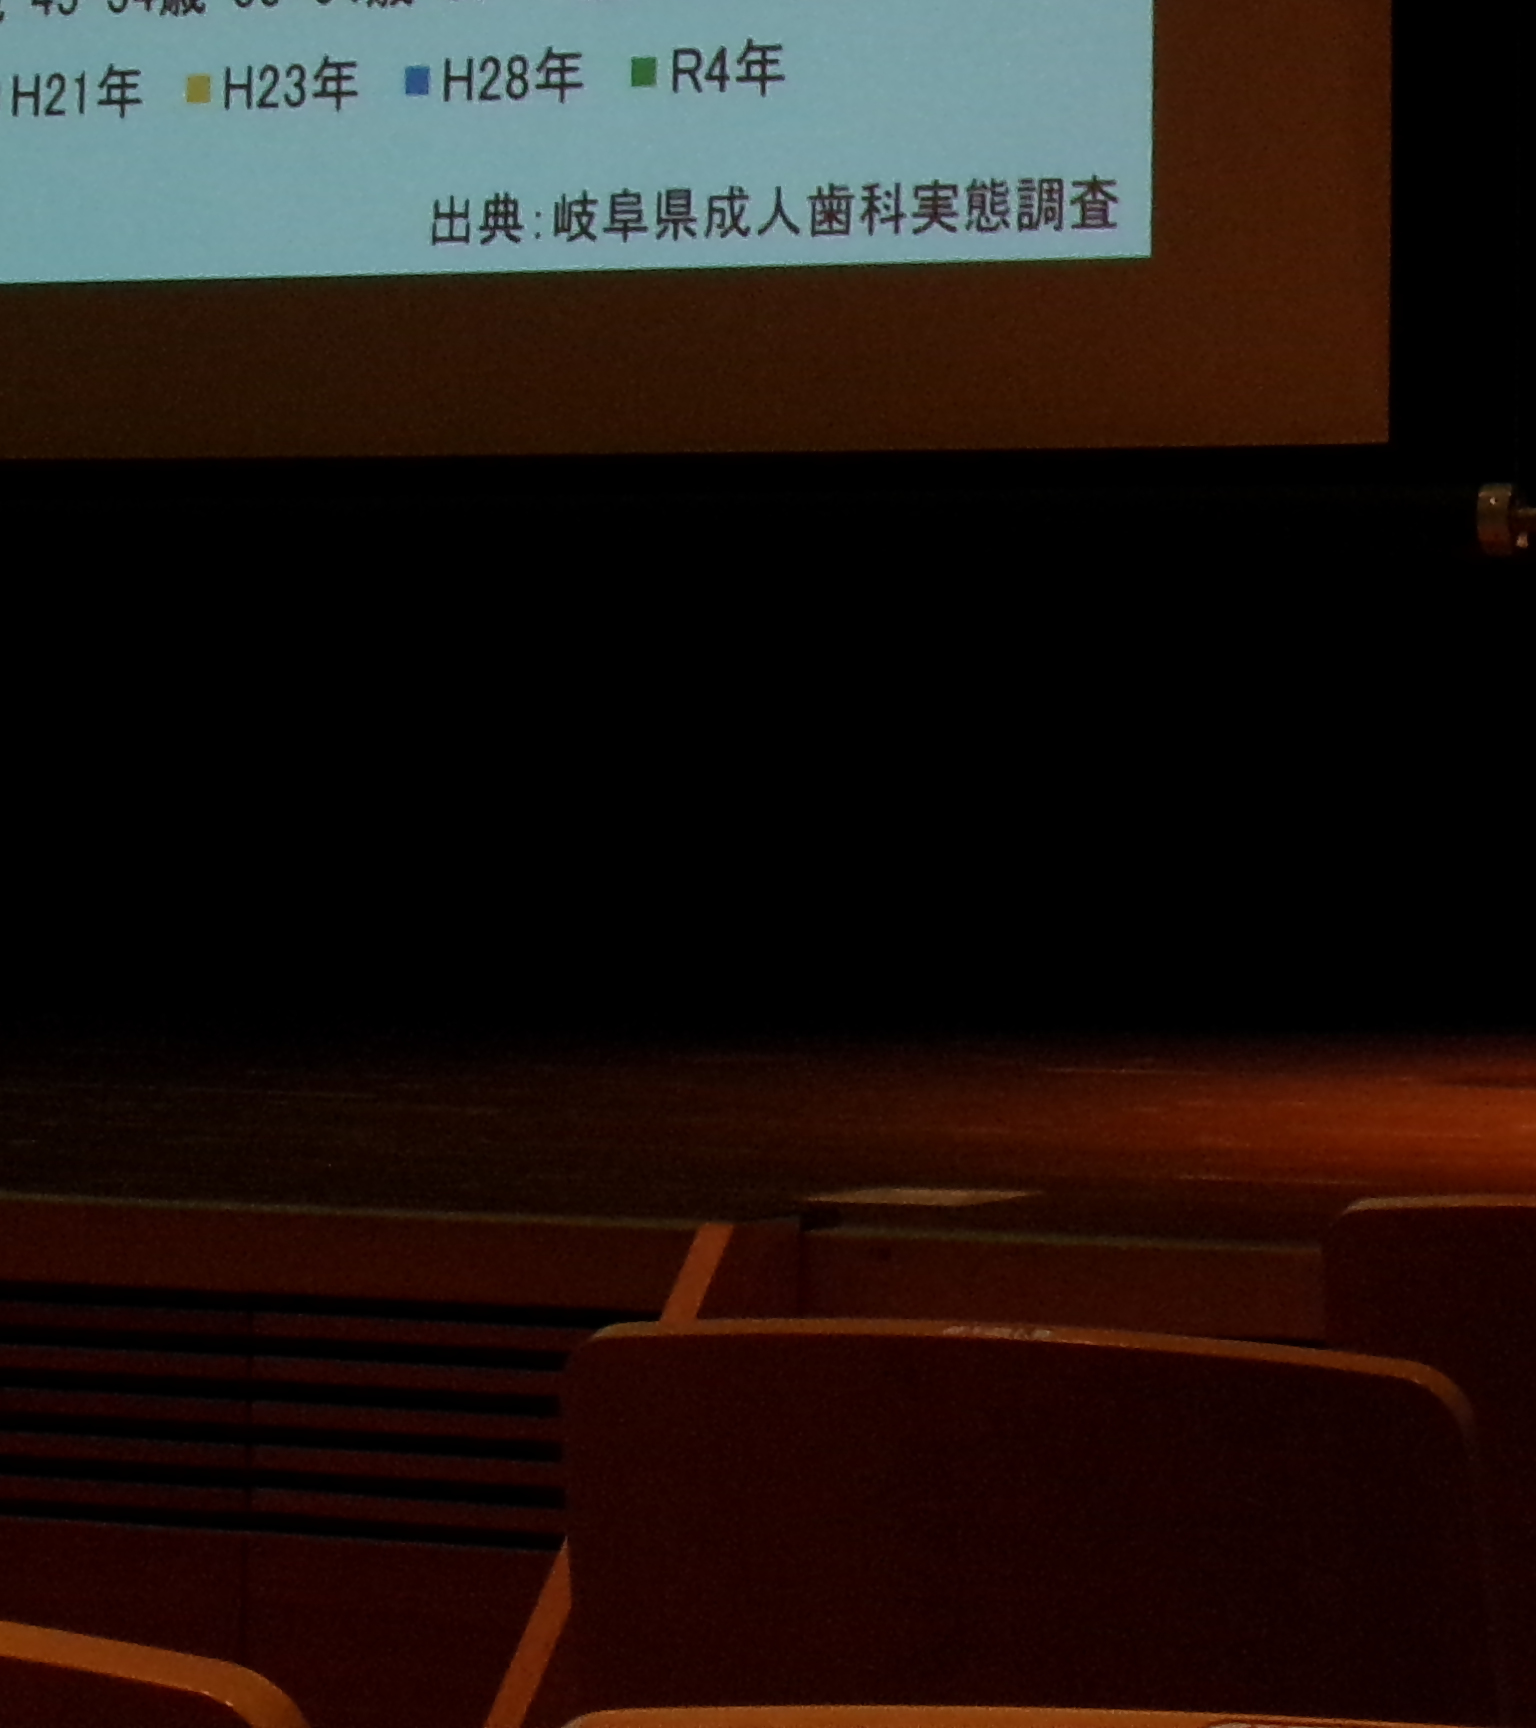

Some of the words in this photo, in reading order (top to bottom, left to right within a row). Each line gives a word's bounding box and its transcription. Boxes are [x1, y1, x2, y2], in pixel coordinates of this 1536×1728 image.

[12, 64, 142, 119] H21年
[224, 55, 358, 112] H23年
[443, 46, 583, 103] H28年
[672, 38, 785, 97] R4年
